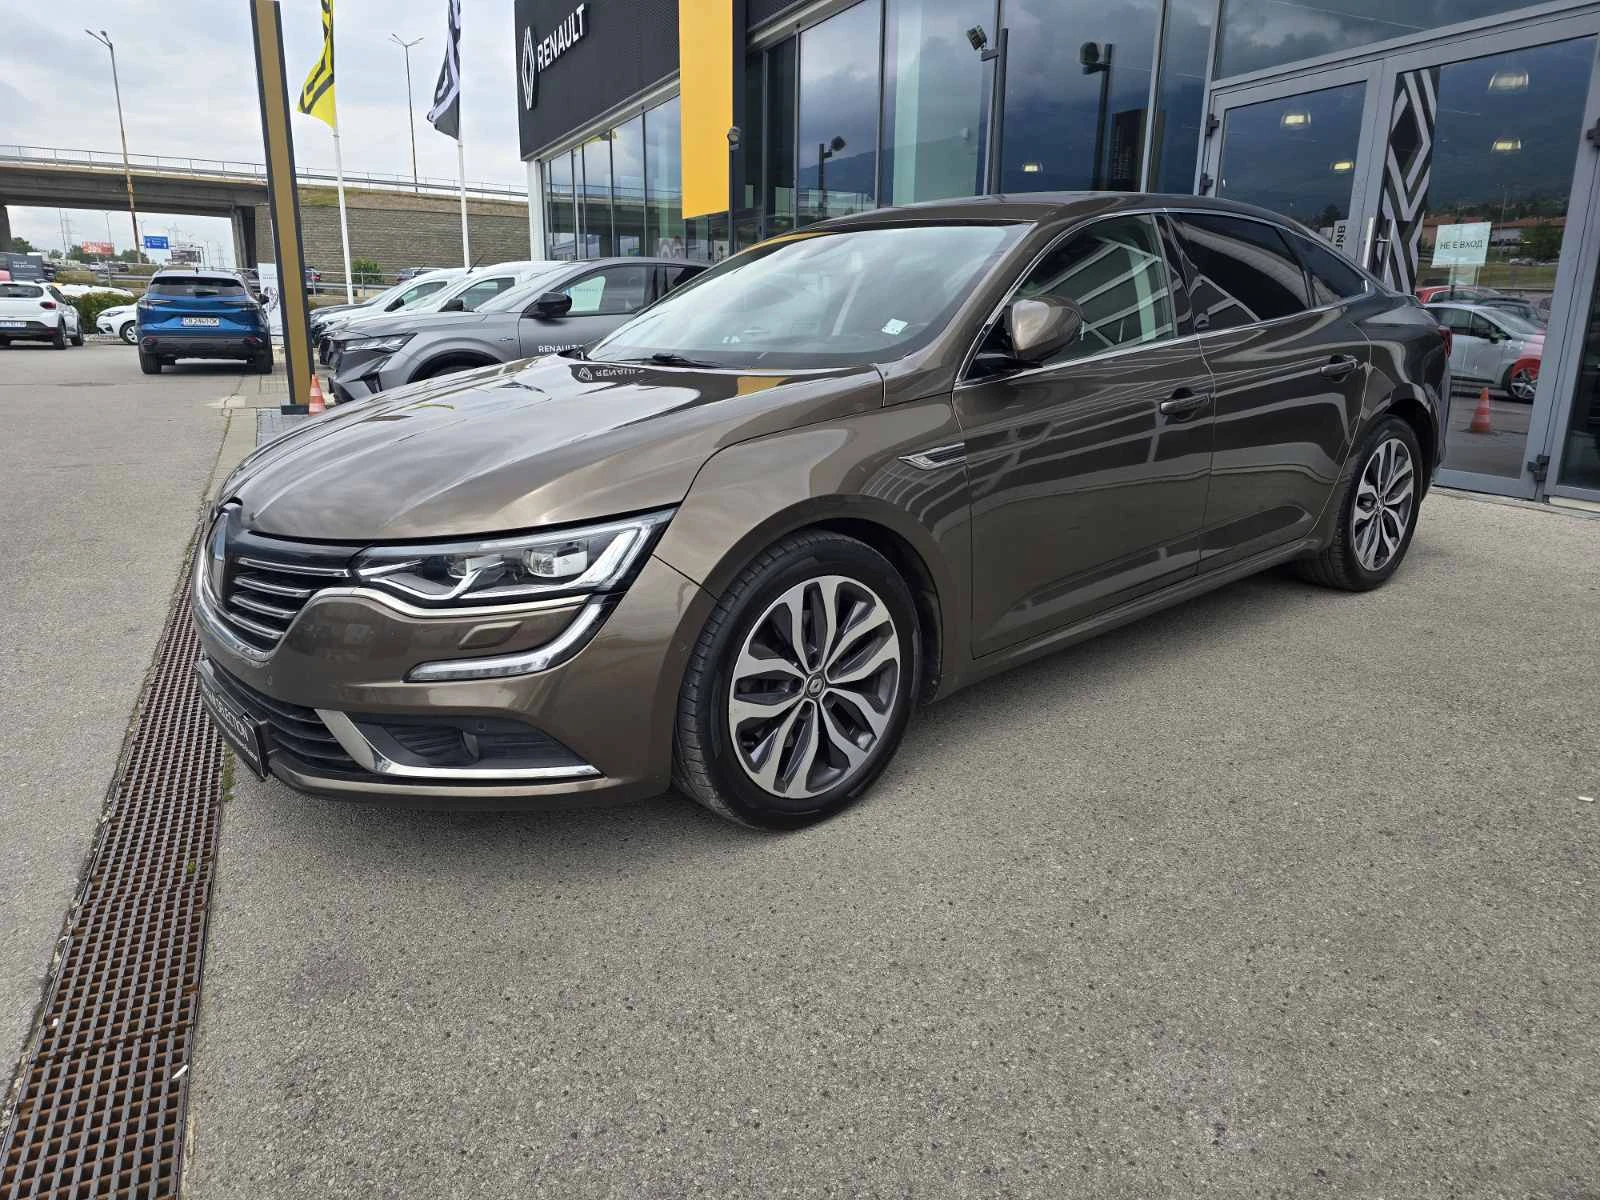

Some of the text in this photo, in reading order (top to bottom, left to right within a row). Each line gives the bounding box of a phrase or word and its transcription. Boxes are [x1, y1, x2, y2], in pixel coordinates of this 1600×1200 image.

[537, 3, 585, 73] RENAULT
[1440, 241, 1450, 249] НЕ
[1460, 240, 1483, 248] ВХОД
